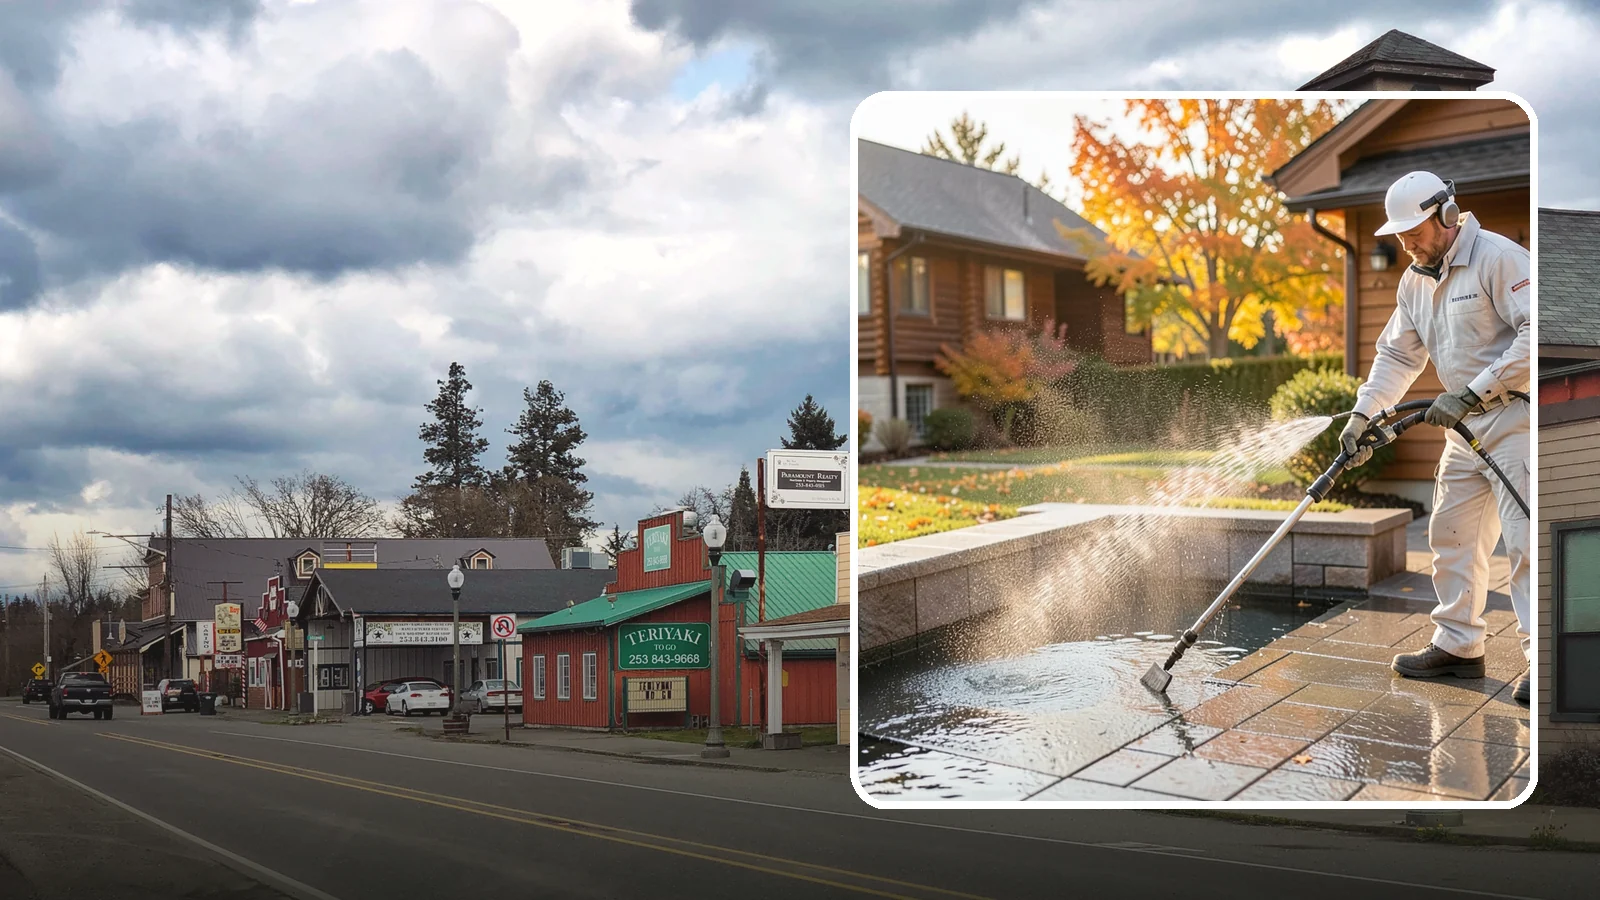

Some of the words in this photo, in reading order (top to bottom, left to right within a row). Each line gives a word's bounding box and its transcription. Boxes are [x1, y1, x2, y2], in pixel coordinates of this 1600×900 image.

[625, 628, 702, 646] TERIYAKI
[629, 654, 648, 664] 253
[652, 654, 700, 664] 843-9668
